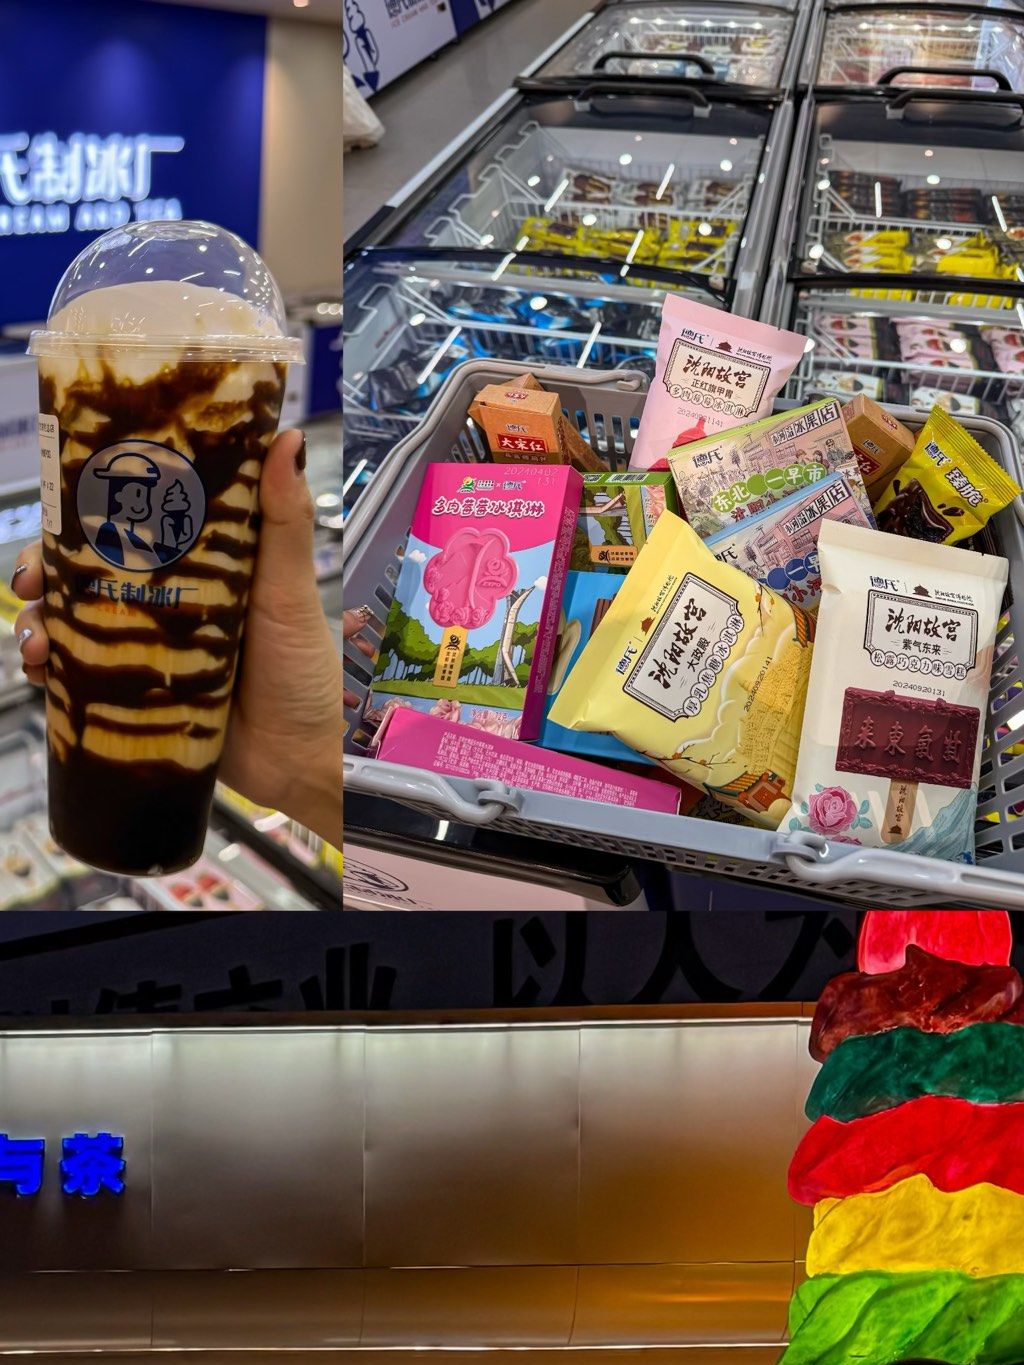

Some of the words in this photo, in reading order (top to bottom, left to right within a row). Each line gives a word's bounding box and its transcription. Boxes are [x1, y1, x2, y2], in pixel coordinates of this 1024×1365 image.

[682, 328, 705, 345] 德氏
[682, 354, 752, 389] 沈阳故宫
[771, 404, 839, 446] 小河沿冰果店
[501, 436, 544, 451] 大宋红
[692, 446, 723, 468] 德氏
[432, 496, 545, 518] 多肉莓莓冰淇淋
[784, 482, 849, 536] 小河沿冰果店
[869, 576, 899, 594] 德氏
[885, 607, 961, 642] 沈阳故宫
[649, 598, 707, 689] 沈阳故宫
[687, 637, 711, 672] 大政殿
[902, 638, 941, 656] 紫气东来
[615, 646, 638, 675] 德氏
[684, 615, 744, 716] 厚乳焦糖冰淇淋
[871, 649, 967, 679] 松露巧克力味雪糕
[893, 681, 946, 697] 20240920131
